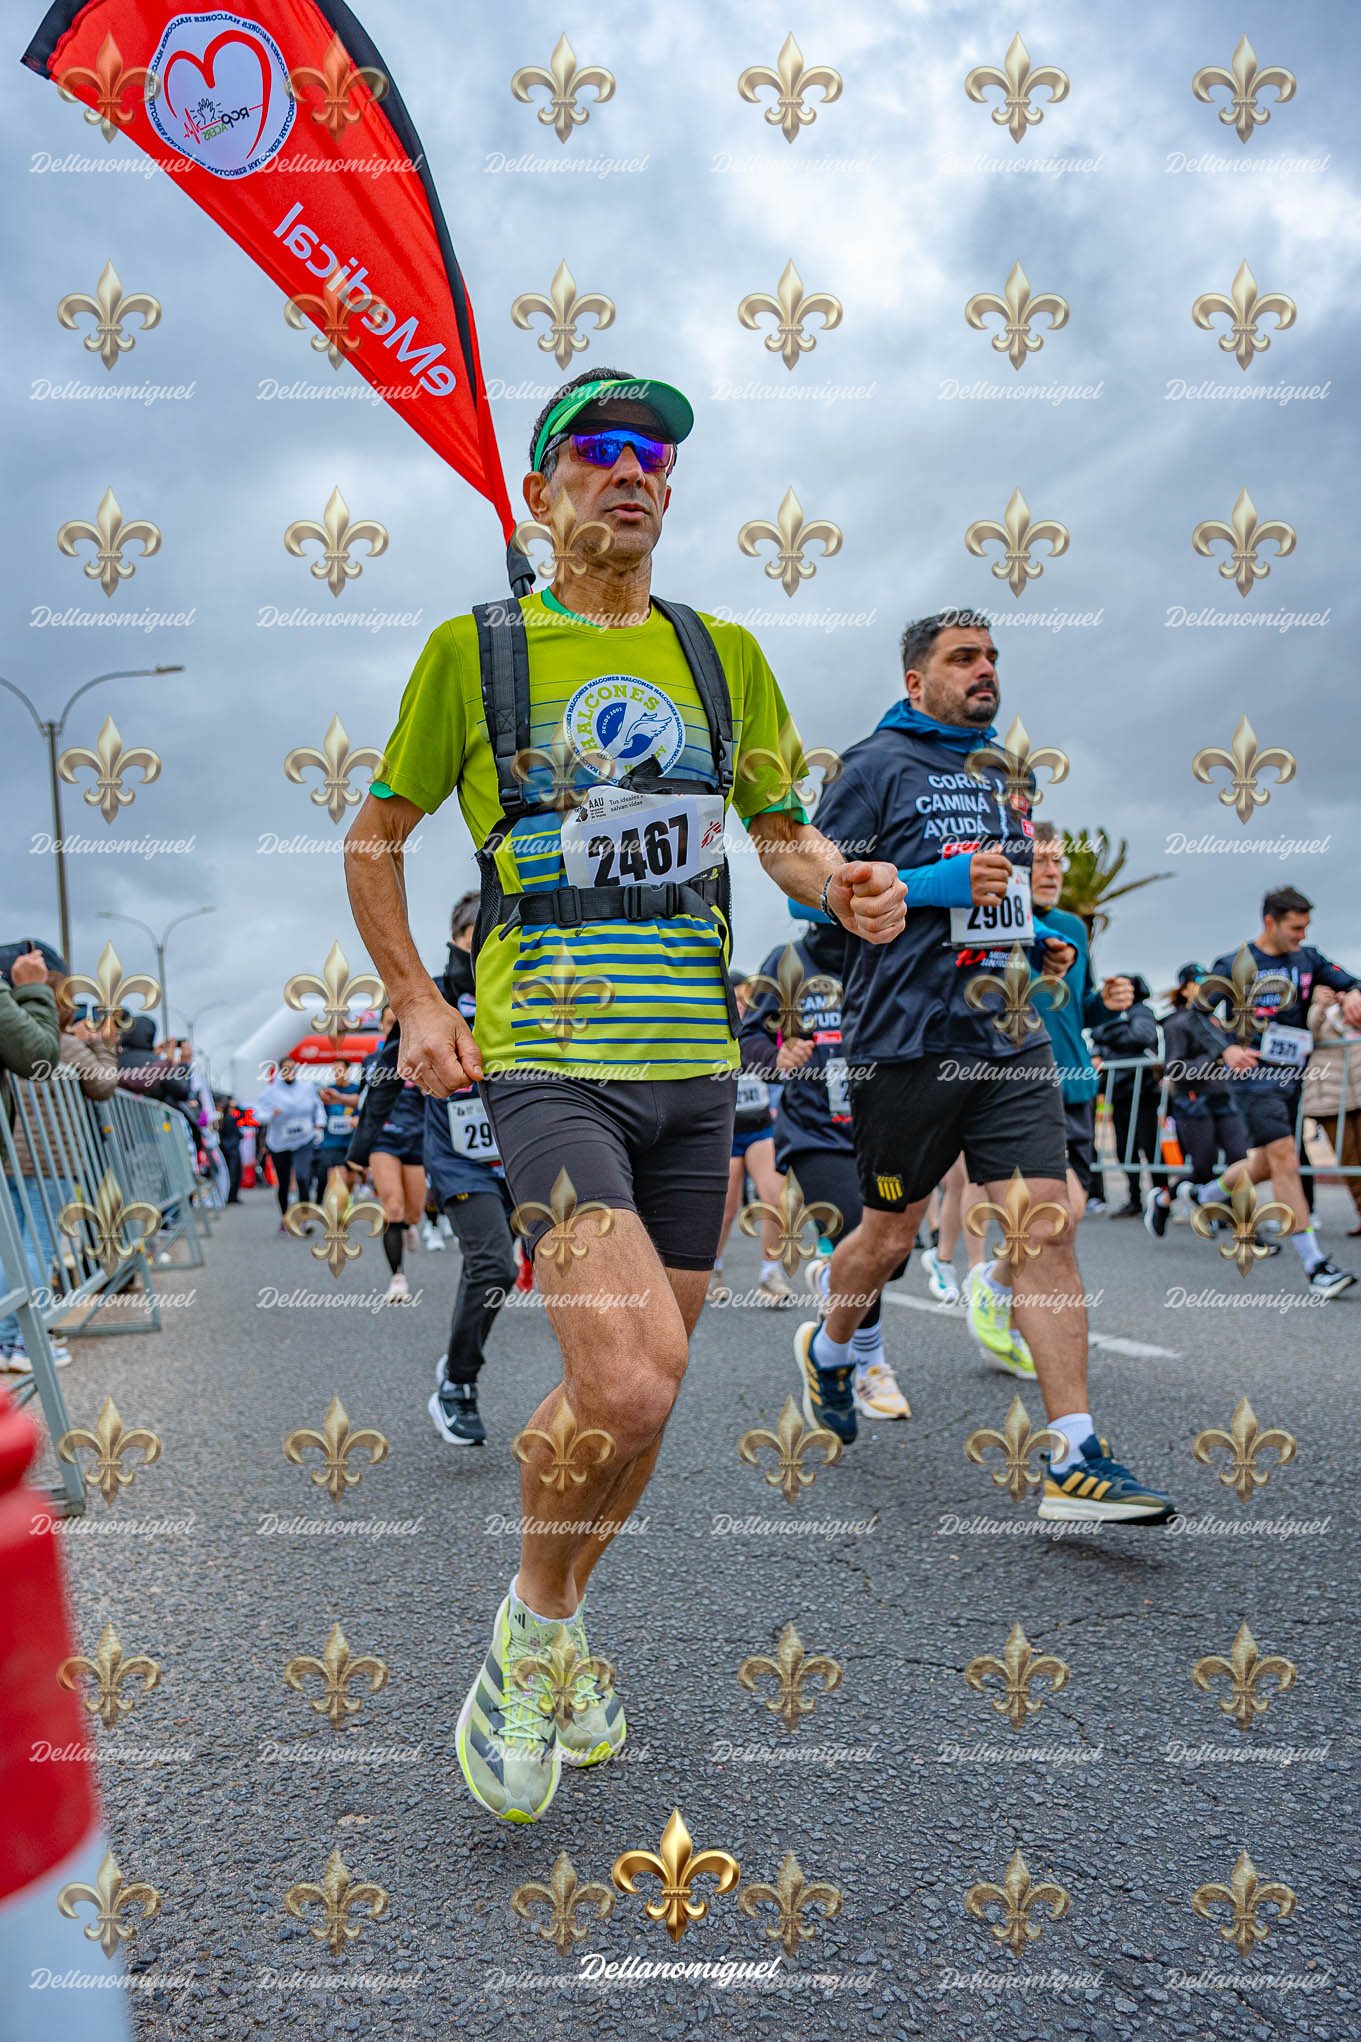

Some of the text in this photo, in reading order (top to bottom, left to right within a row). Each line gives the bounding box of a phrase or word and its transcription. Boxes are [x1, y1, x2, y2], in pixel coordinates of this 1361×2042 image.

[620, 676, 654, 690] HALCONES
[653, 688, 678, 716] HALCONES
[577, 684, 660, 753] HALCONES
[589, 797, 604, 809] AAU
[915, 792, 991, 814] CAMINÁ
[924, 815, 992, 839] AYUDÁ
[588, 813, 689, 887] 2467
[967, 895, 1025, 930] 2908
[465, 1122, 493, 1150] 29
